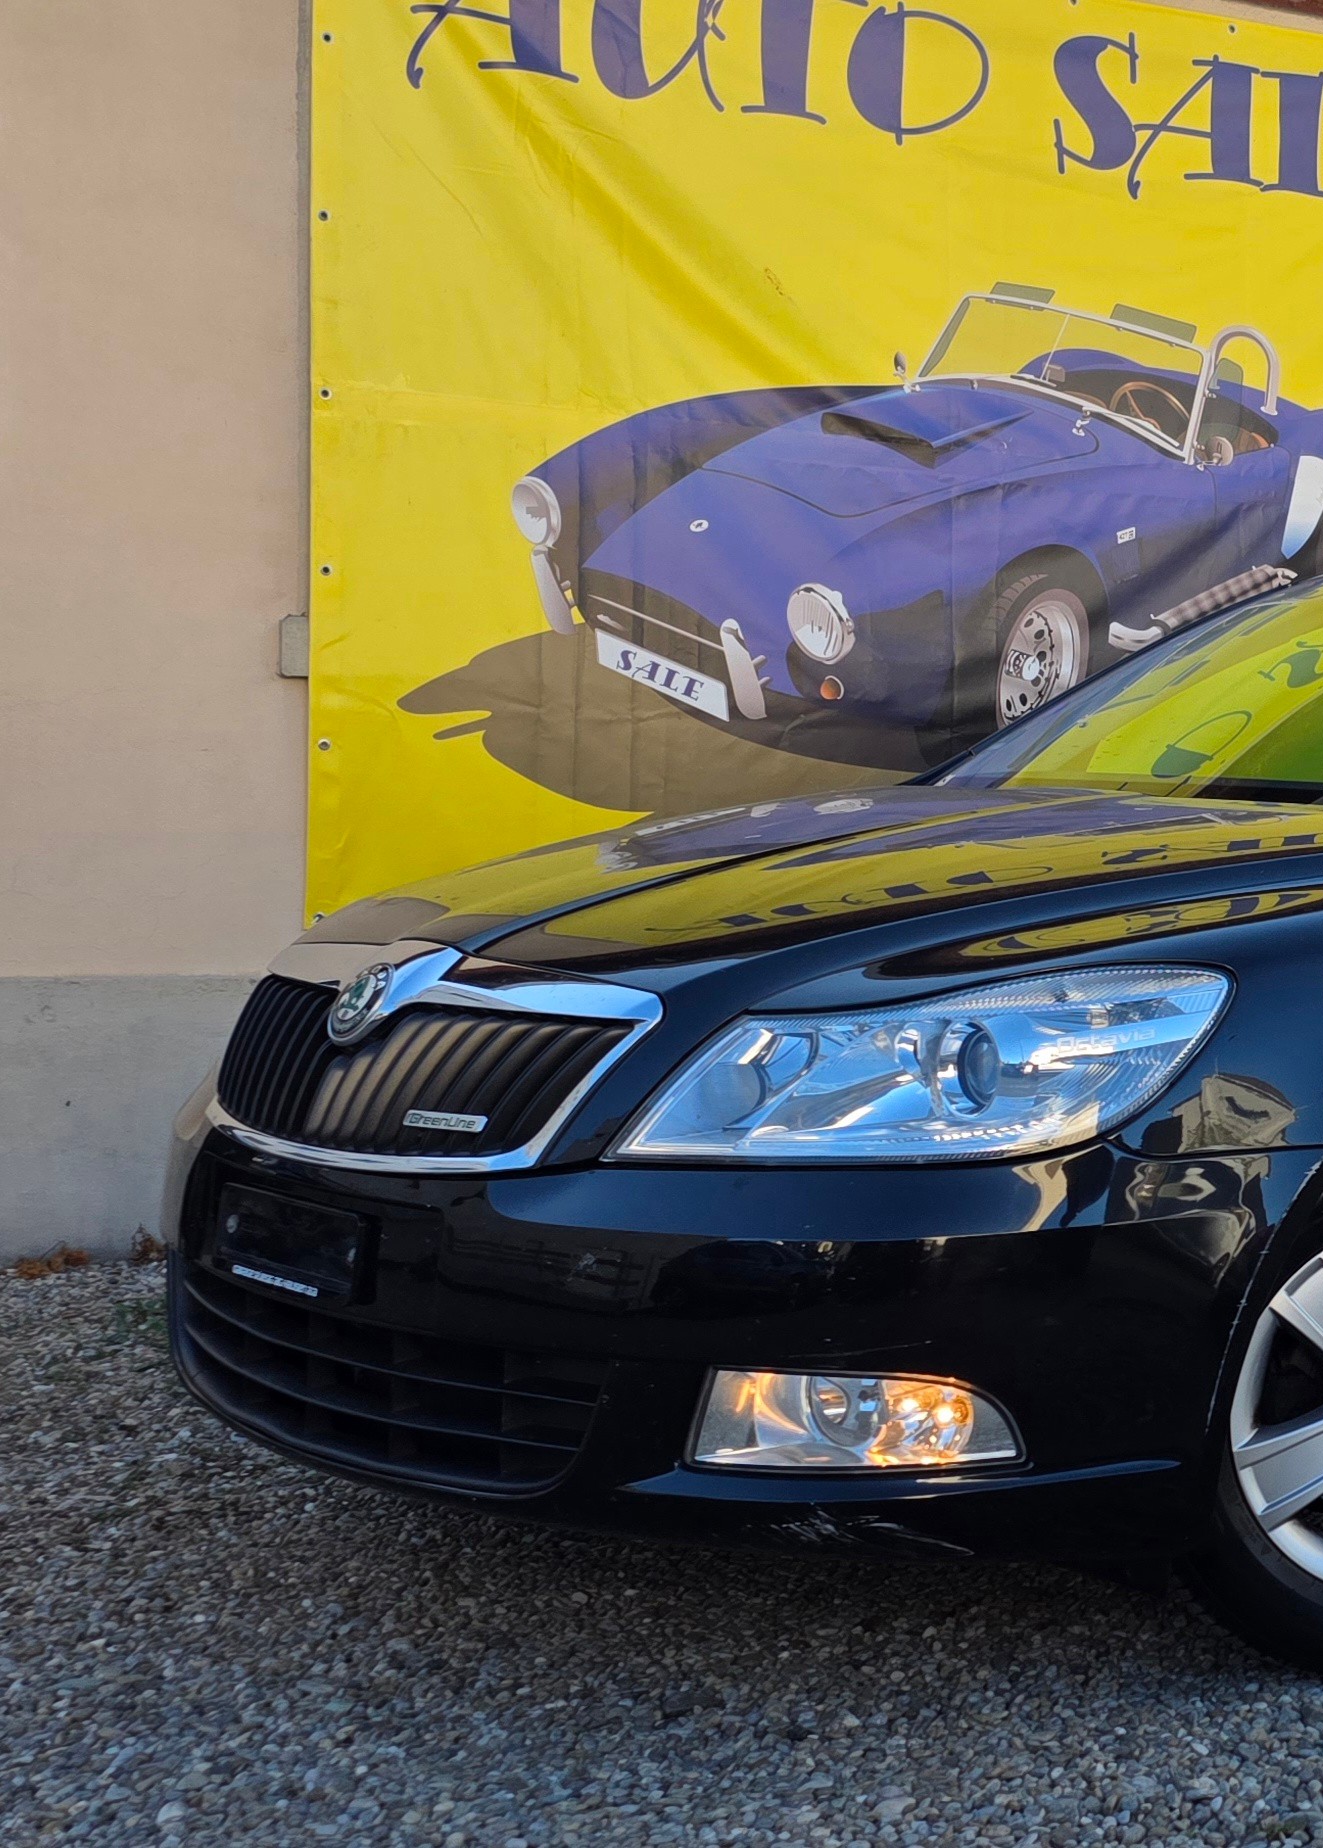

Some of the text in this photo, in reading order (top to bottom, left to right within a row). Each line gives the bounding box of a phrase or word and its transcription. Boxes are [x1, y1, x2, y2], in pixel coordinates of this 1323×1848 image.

[409, 0, 990, 145] AUTO
[615, 649, 705, 702] SALE
[1056, 1027, 1156, 1054] Octavia
[407, 1112, 477, 1130] GreenLine
